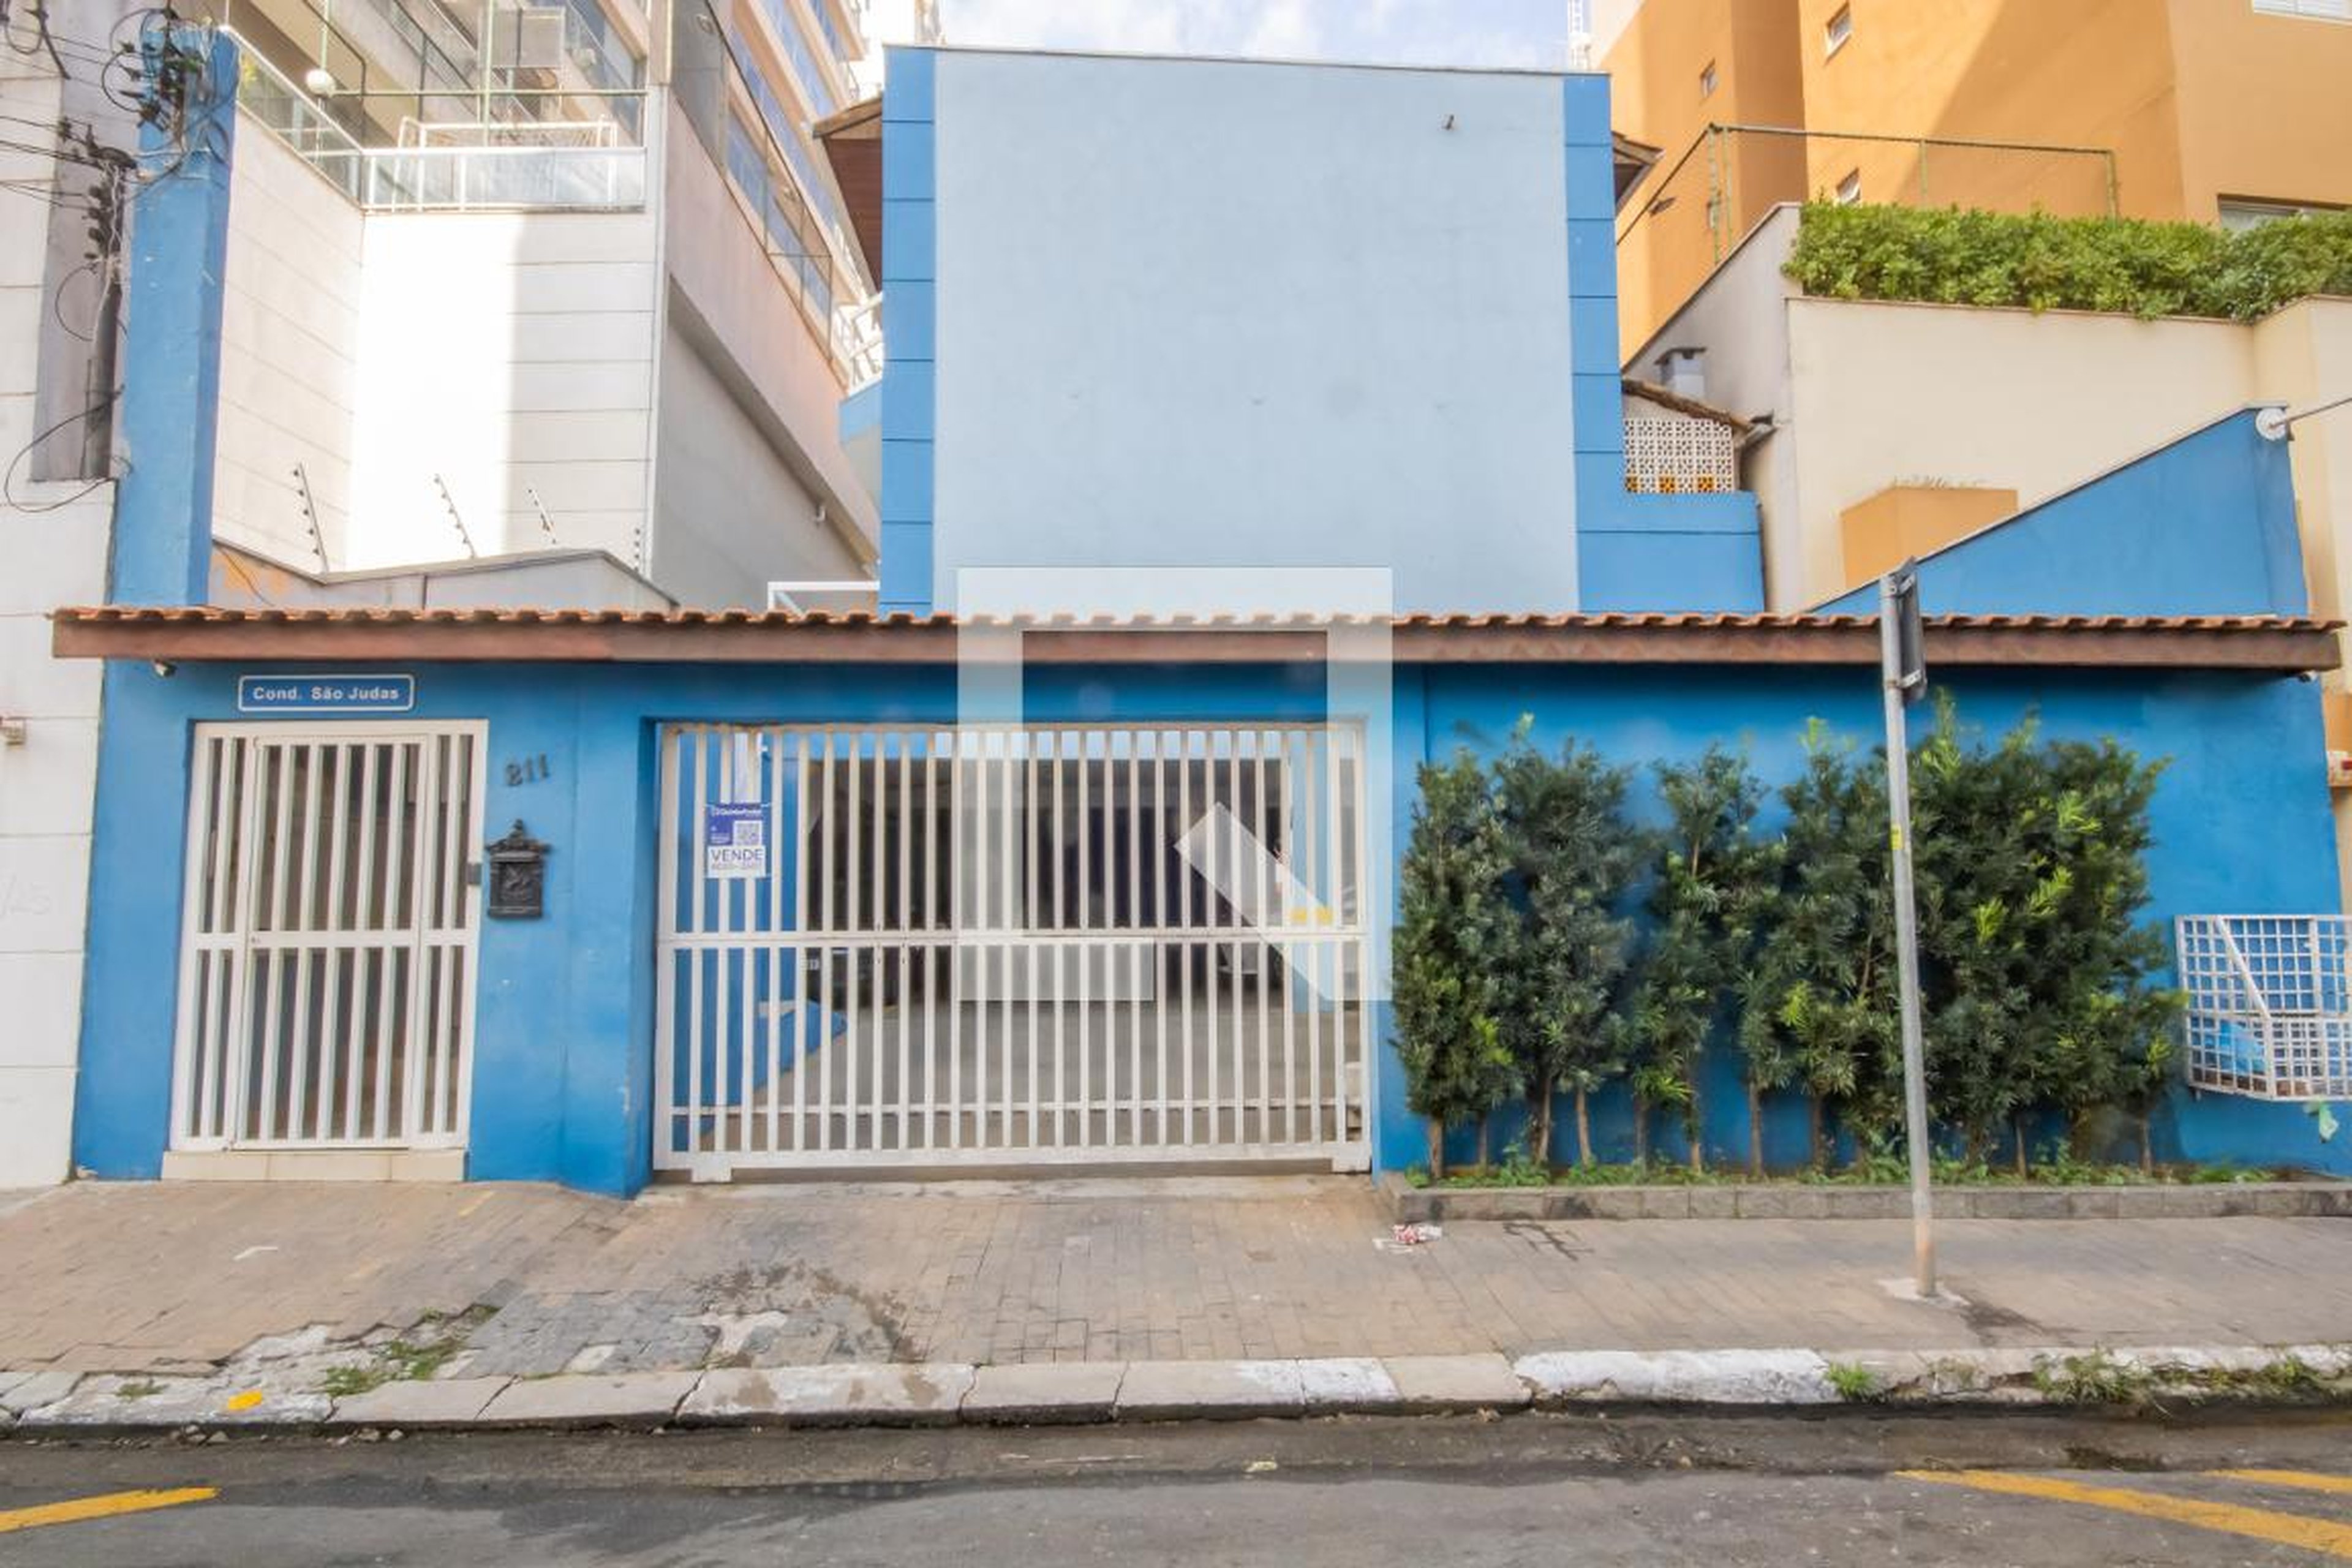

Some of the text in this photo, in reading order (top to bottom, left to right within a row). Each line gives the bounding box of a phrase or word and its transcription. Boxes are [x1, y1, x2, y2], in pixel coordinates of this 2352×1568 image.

[252, 685, 399, 700] Cond. São Judas
[710, 848, 764, 862] VENDE
